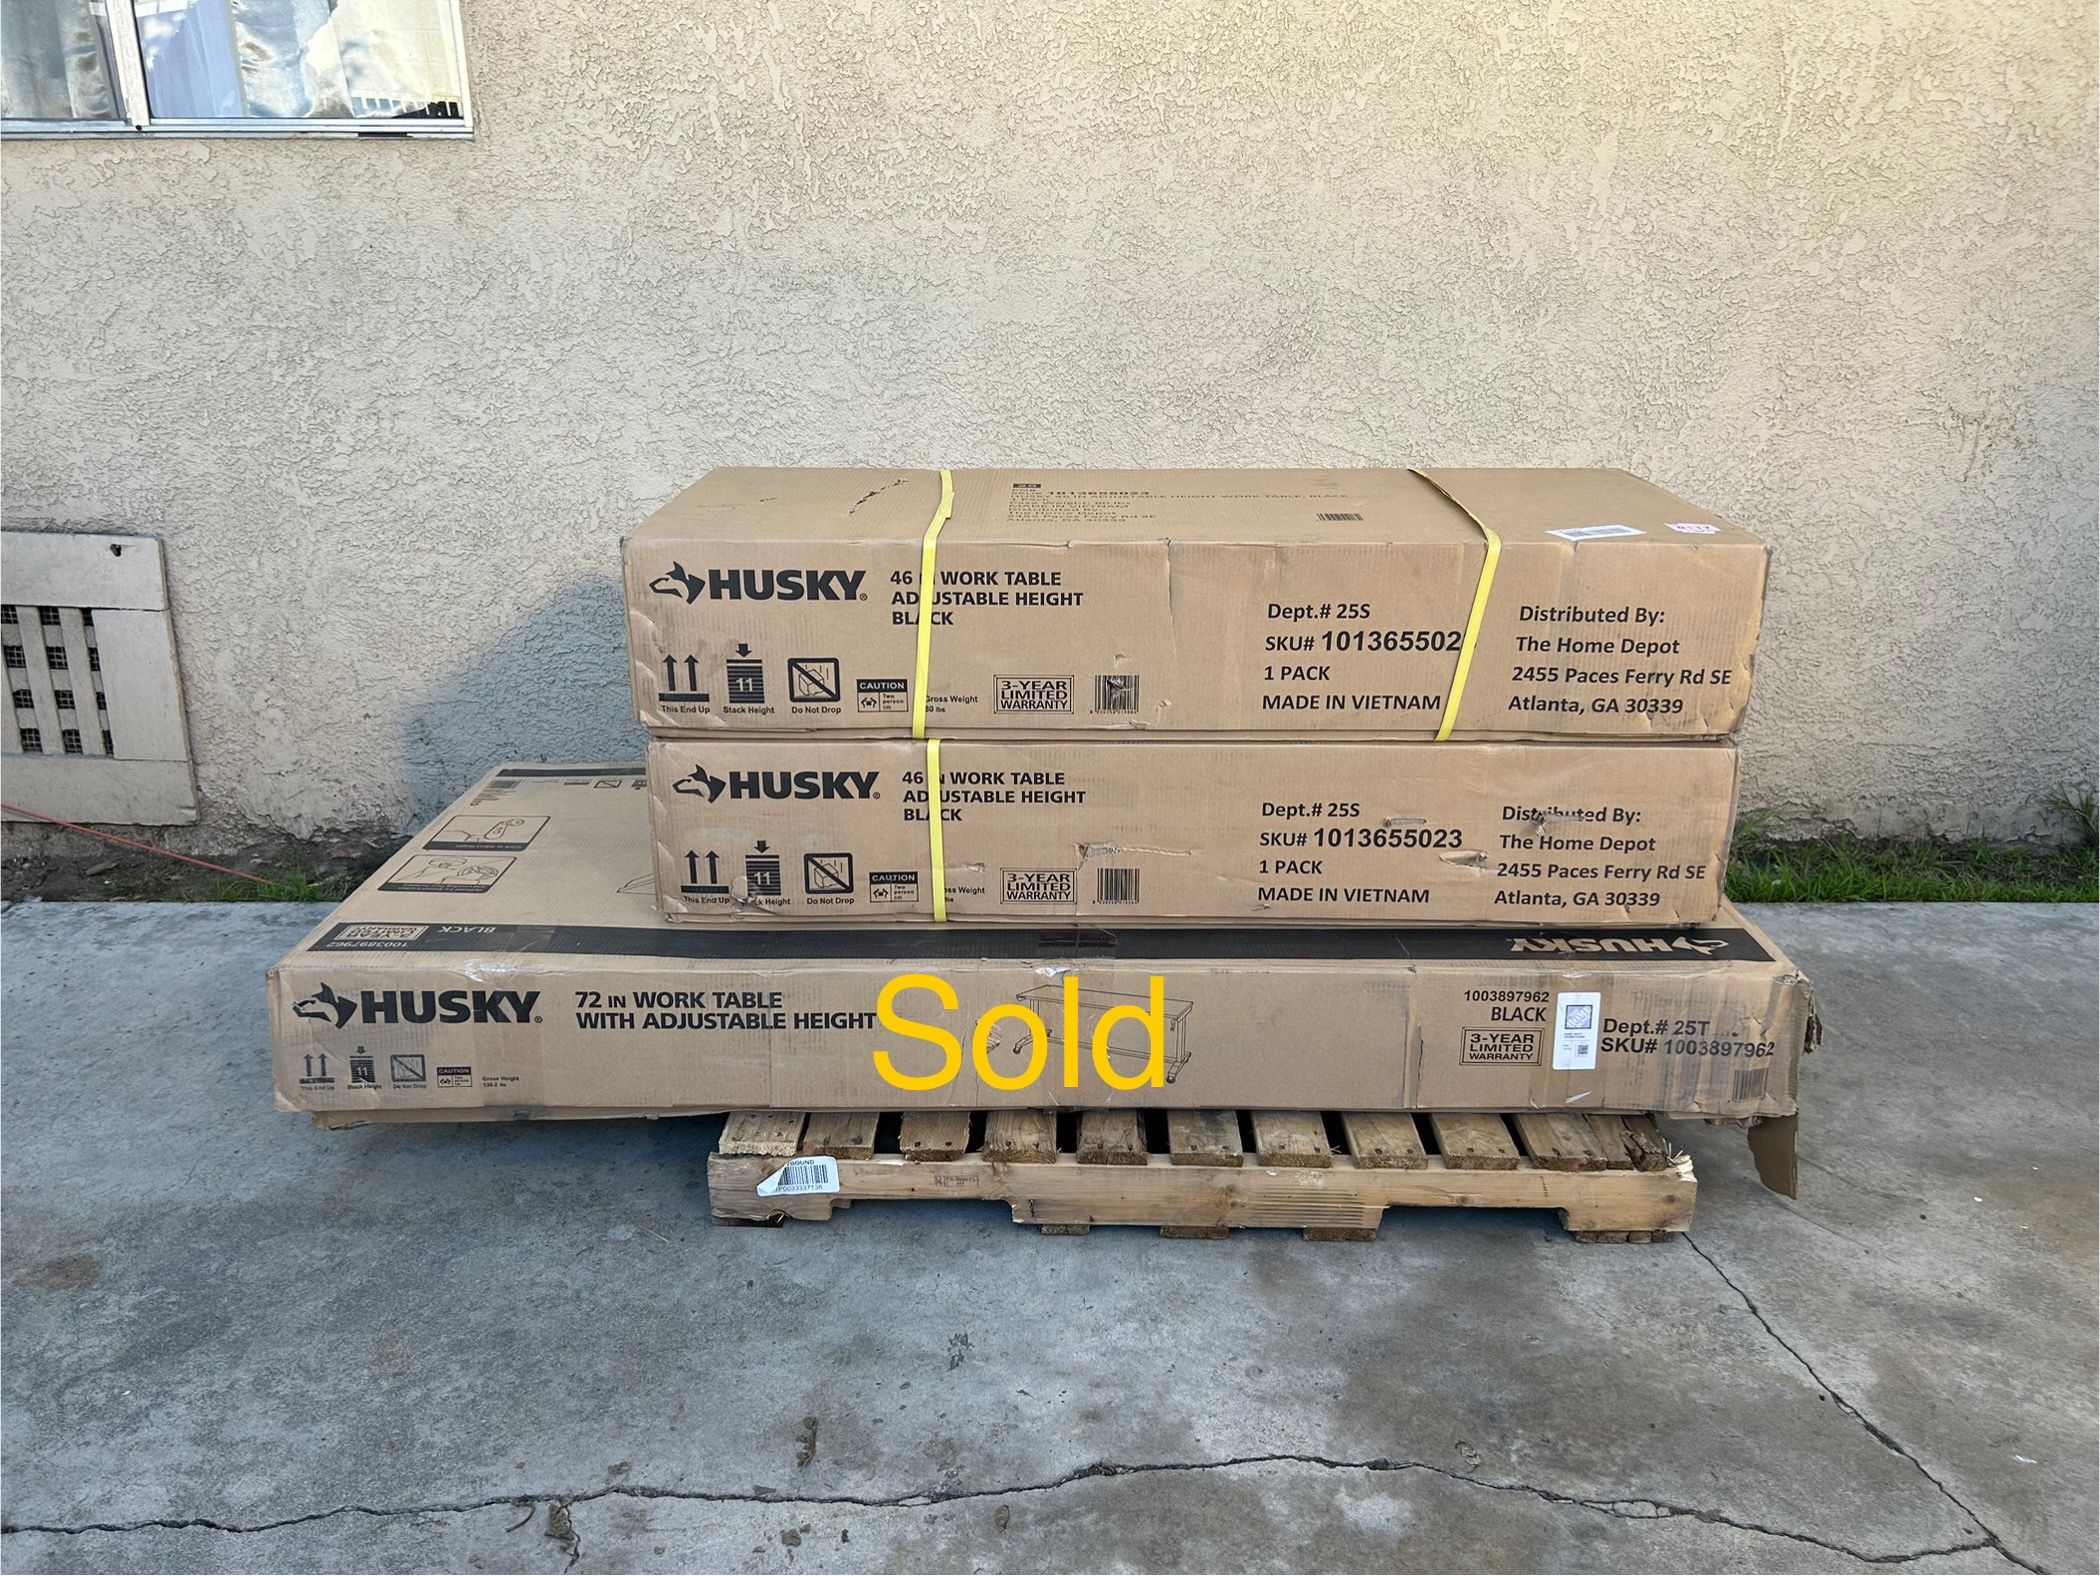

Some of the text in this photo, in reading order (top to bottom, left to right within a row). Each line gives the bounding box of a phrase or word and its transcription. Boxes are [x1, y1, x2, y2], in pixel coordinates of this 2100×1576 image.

[708, 569, 867, 601] HUSKY
[890, 571, 1062, 586] 46 WORK TABLE
[891, 592, 1084, 606] ADUSTABLE HEIGHT
[1267, 603, 1371, 622] Dept.# 25S
[1519, 606, 1665, 627] Distributed By:
[1265, 636, 1315, 651] SKU#
[1516, 636, 1680, 657] The Home Depot
[1264, 666, 1331, 681] 1 PACK
[1512, 666, 1733, 688] 2455 Paces Ferry Rd SE
[735, 677, 753, 692] 11
[859, 682, 905, 690] CAUTION
[1001, 680, 1067, 690] 3-YEAR
[949, 695, 978, 705] Weight
[1001, 690, 1068, 700] LIMITED
[1262, 695, 1441, 710] MADE IN VIETNAM
[661, 705, 711, 715] This End Up
[723, 705, 775, 715] Stack Height
[791, 706, 842, 716] Do Not Drop
[1000, 700, 1068, 710] WARRANTY
[1508, 695, 1684, 716] Atlanta, GA 30339
[729, 771, 880, 800] HUSKY
[901, 771, 1066, 785] 46 WORK TABLE
[903, 790, 1087, 804] ADUSTABLE HEIGHT
[1261, 802, 1360, 820] Dept.# 25S
[1612, 807, 1641, 826] By:
[1259, 828, 1463, 848] SKU# 1013655023
[1500, 834, 1656, 854] The Home Depot
[1259, 860, 1323, 875] 1 PACK
[1497, 862, 1706, 882] 2455 Paces Ferry Rd SE
[1007, 873, 1071, 882] 3-YEAR
[957, 886, 985, 896] Weight
[1007, 882, 1071, 891] LIMITED
[684, 896, 730, 905] This End Up
[806, 897, 855, 907] Do Not Drop
[1006, 891, 1071, 900] WARRANTY
[1258, 887, 1430, 903] MADE IN VIETNAM
[1494, 890, 1661, 909] Atlanta, GA 30339
[437, 925, 497, 933] BLACK
[1510, 938, 1674, 952] HUSKY
[575, 991, 782, 1009] 72 IN WORK TABLE
[1464, 990, 1550, 1003] 1003897962
[361, 990, 541, 1024] HUSKY
[1491, 1006, 1548, 1022] BLACK
[576, 1012, 877, 1030] WITH ADJUSTABLE HEIGHT
[1602, 1018, 1711, 1038] Dept.# 25T
[1470, 1033, 1534, 1044] 3-YEAR
[1469, 1043, 1534, 1052] LIMITED
[1600, 1037, 1775, 1058] SKU# 1003897962
[1469, 1052, 1534, 1061] WARRANTY
